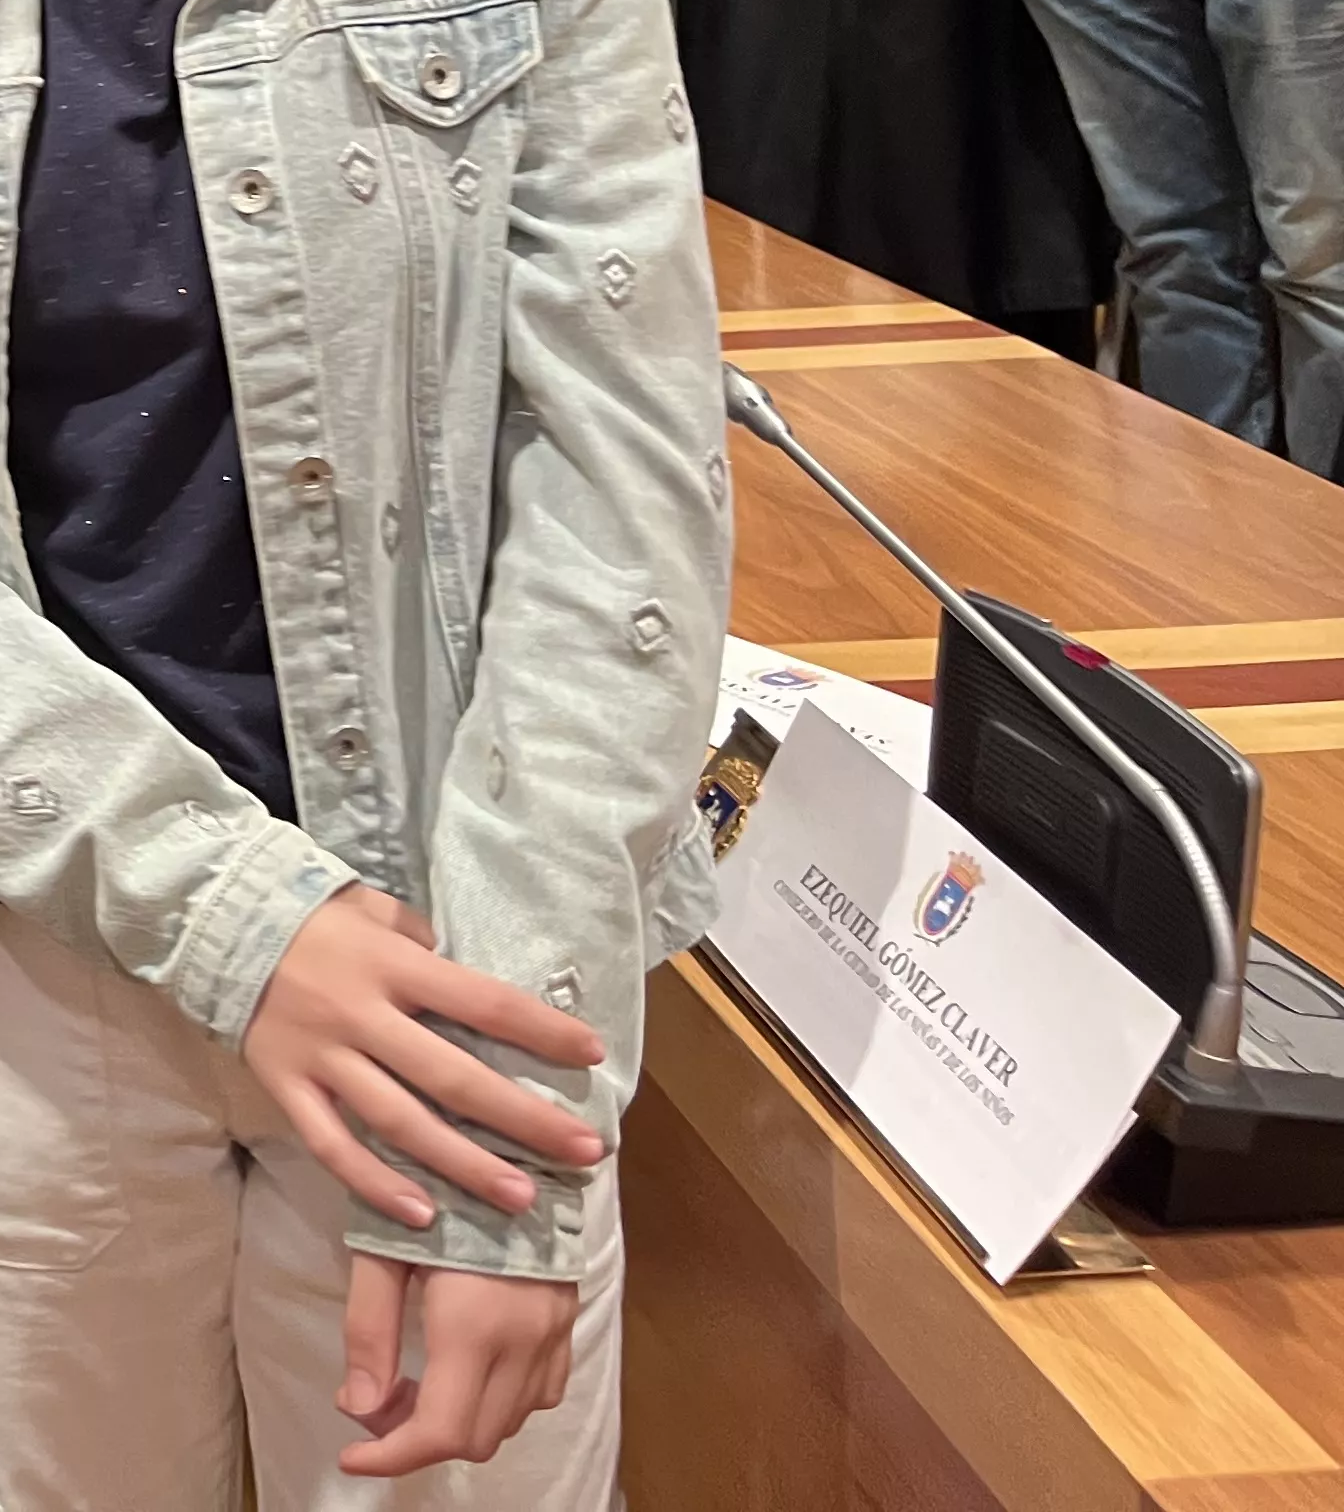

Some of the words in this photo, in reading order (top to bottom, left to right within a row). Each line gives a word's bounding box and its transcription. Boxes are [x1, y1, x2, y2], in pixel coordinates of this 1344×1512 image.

[800, 863, 880, 952] EZEQUIEL
[879, 940, 946, 1014] GÓMEZ
[941, 1001, 1019, 1088] CLAVER
